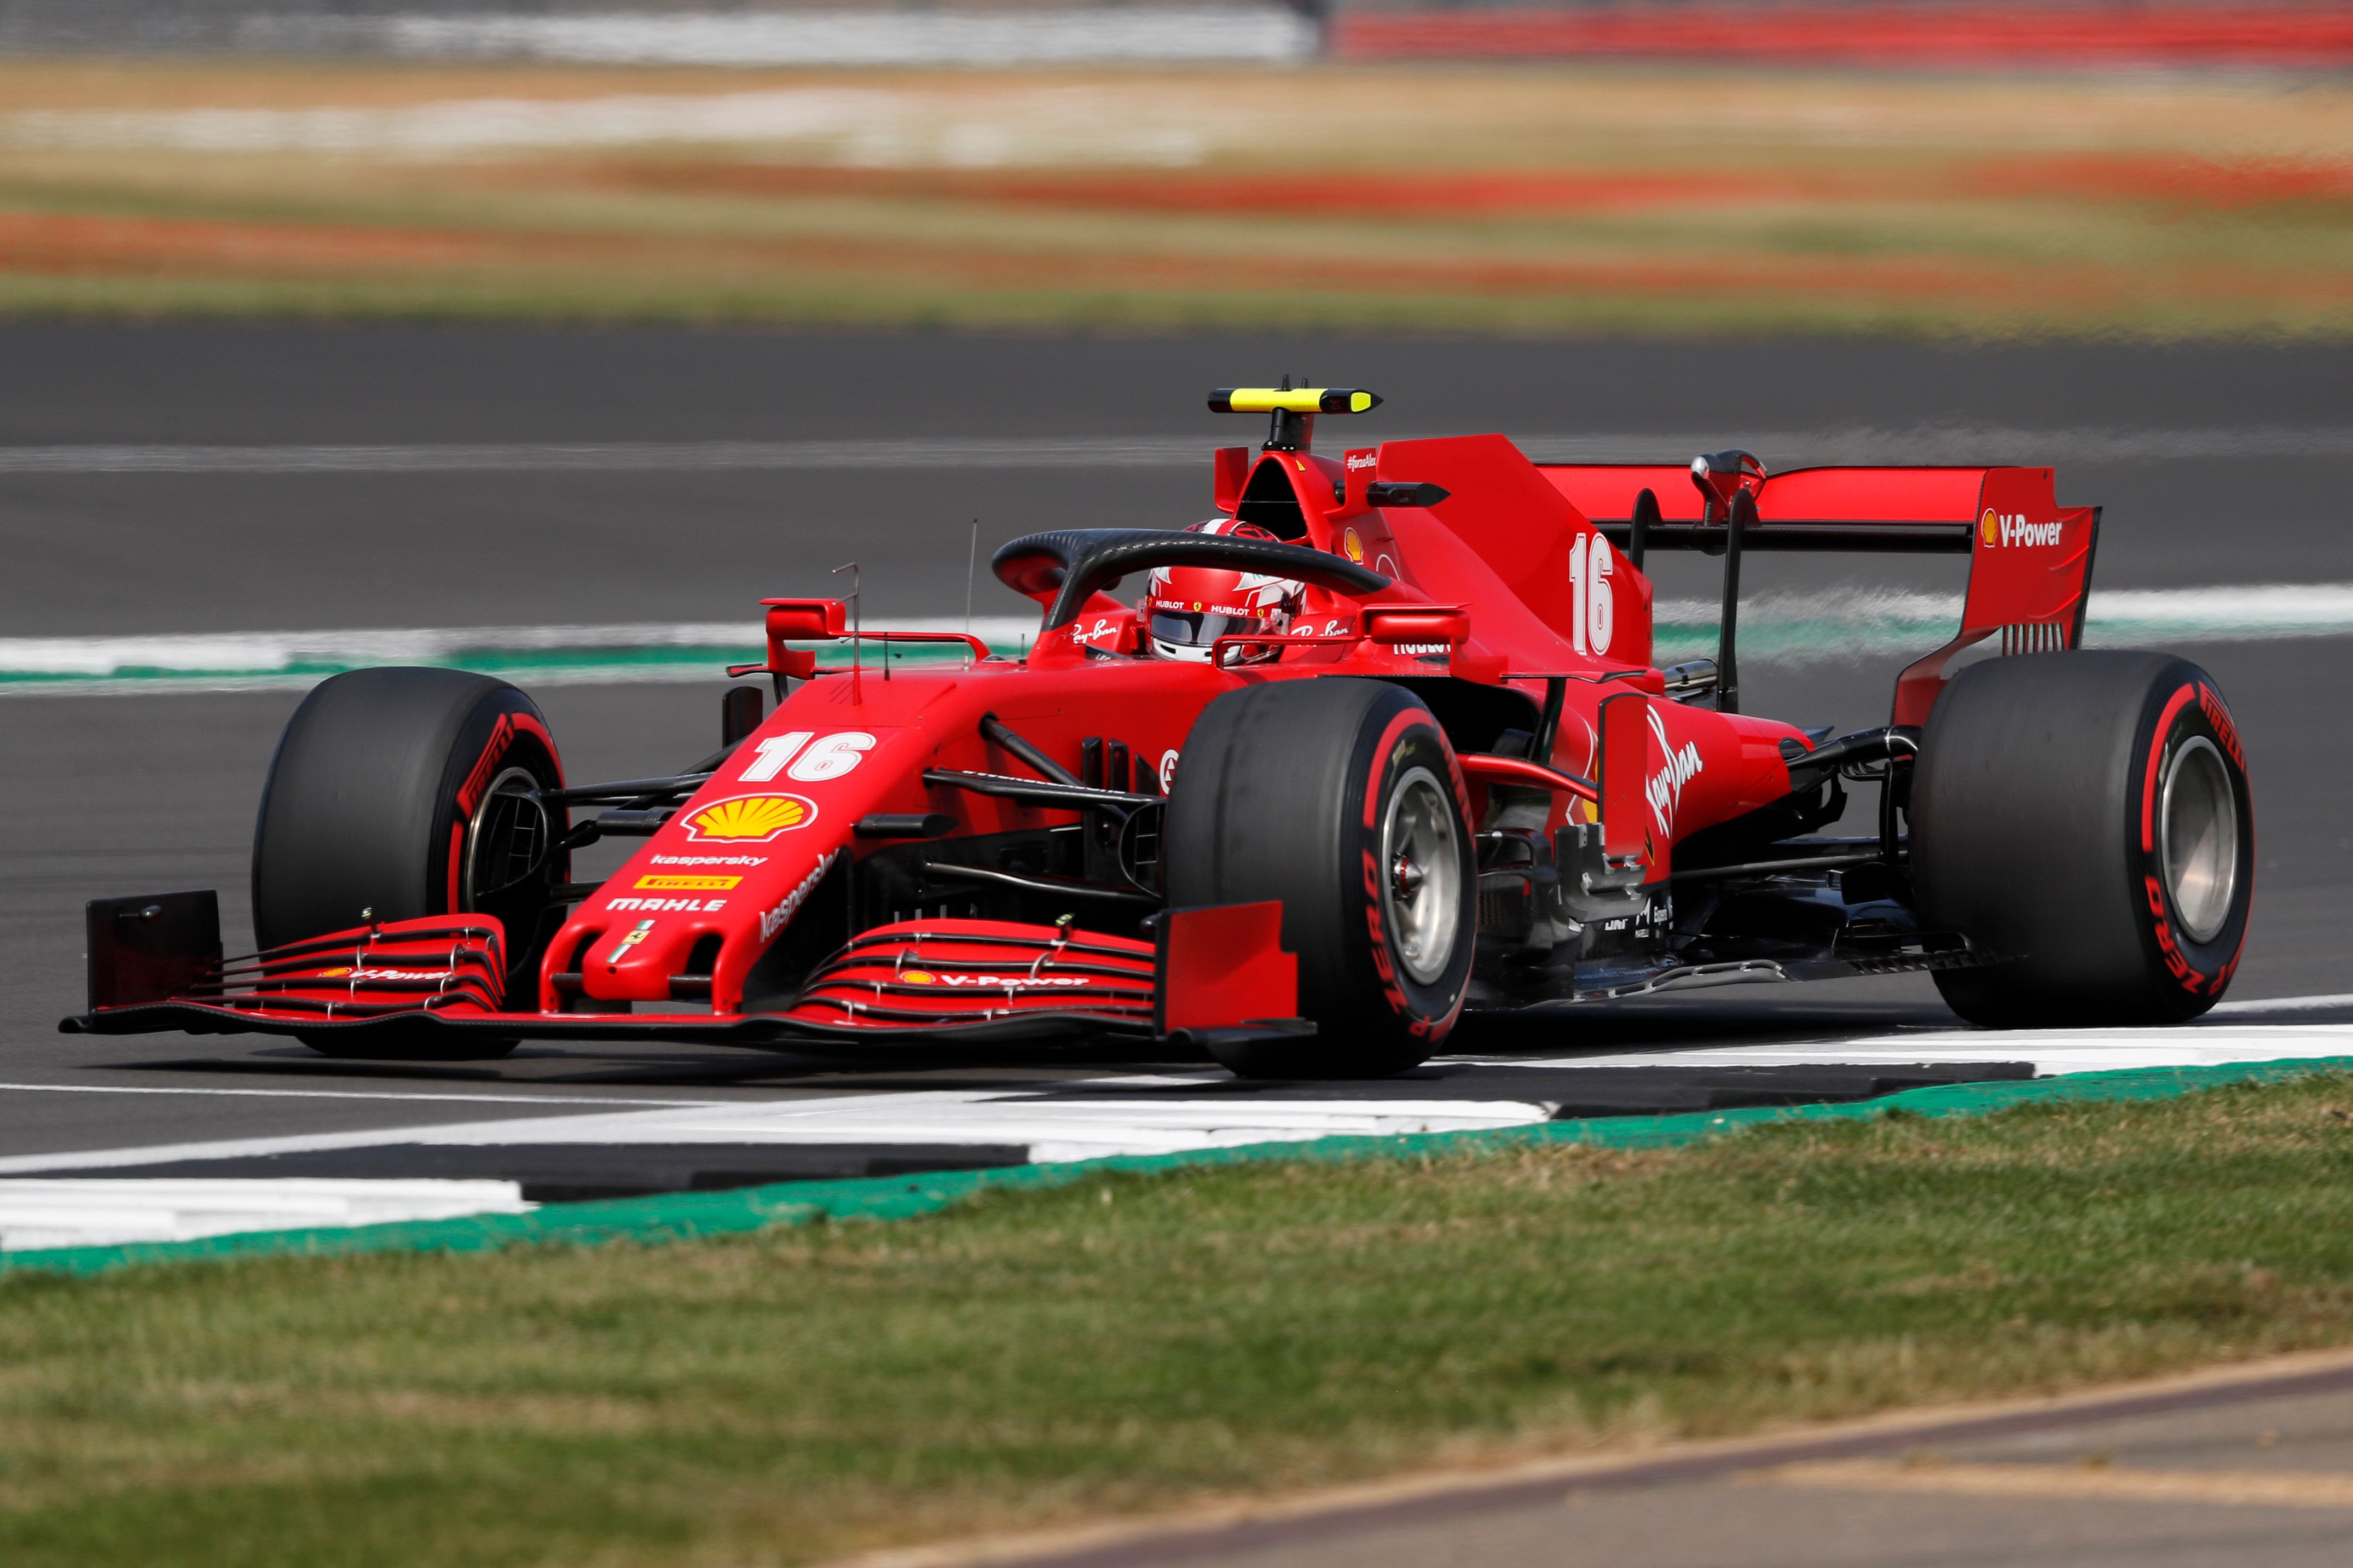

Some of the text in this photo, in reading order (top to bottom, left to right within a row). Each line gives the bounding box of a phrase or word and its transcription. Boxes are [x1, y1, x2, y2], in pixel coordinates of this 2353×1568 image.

[1999, 514, 2062, 547] V-Power
[1569, 532, 1613, 656] 16
[1156, 600, 1184, 609] HUBLOT
[1211, 605, 1249, 616] HUBLOT
[1073, 619, 1117, 644] Ray-Ban
[1291, 620, 1349, 637] R-Ban
[737, 731, 877, 782] 16
[650, 853, 769, 867] kaspersky
[646, 878, 731, 886] PIRELLI
[606, 898, 728, 911] MAHLE
[1362, 849, 1409, 1014] ZERO
[2145, 874, 2205, 994] ZERO
[349, 969, 452, 980] V-Power
[941, 975, 1090, 985] V-Power
